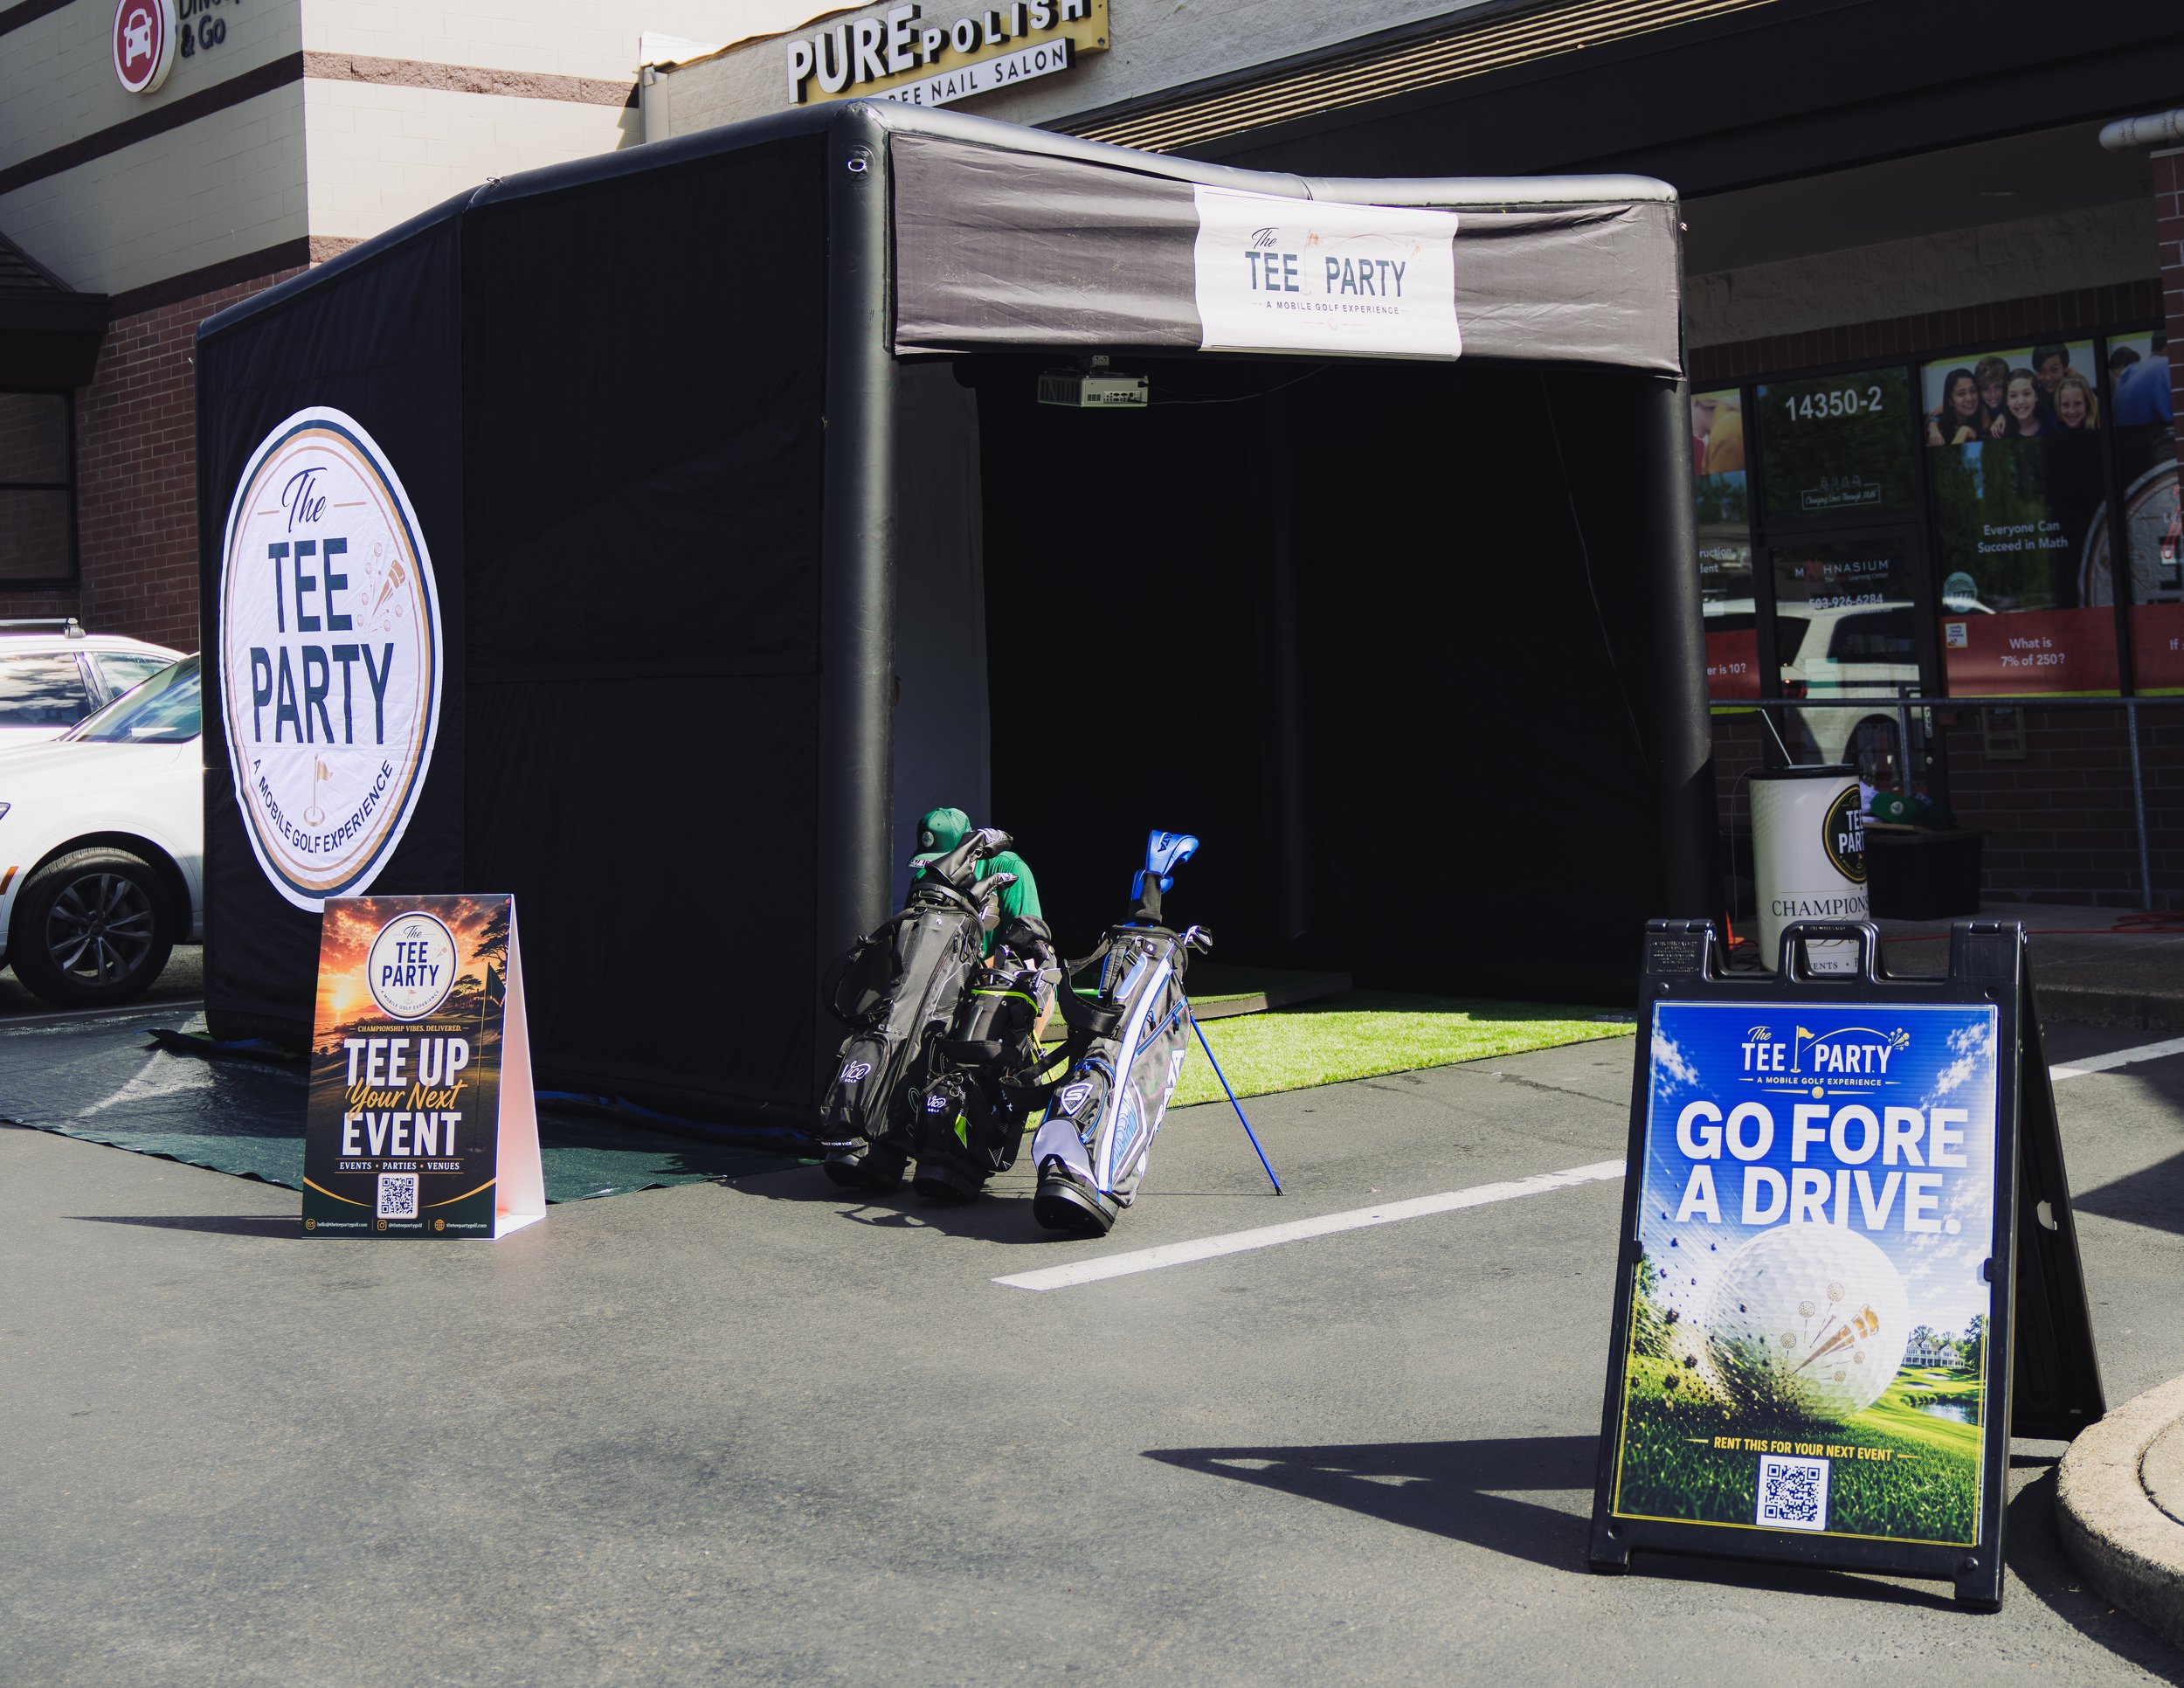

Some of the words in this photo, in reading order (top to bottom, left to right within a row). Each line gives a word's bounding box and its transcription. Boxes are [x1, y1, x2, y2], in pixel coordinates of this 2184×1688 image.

[181, 24, 195, 58] &
[198, 14, 226, 50] Go
[786, 3, 919, 104] PURE
[923, 0, 1089, 65] POLISH
[931, 72, 978, 101] NAIL
[994, 45, 1064, 82] SALON
[1252, 227, 1279, 249] The
[1245, 251, 1300, 292] TEE
[1325, 256, 1406, 297] PARTY
[1276, 301, 1311, 311] MOBILE
[1315, 302, 1339, 312] GOLF
[1343, 304, 1399, 315] EXPERIENCE
[1786, 385, 1883, 421] 14350-2
[281, 467, 328, 533] The
[1983, 523, 2035, 536] Everyone
[2038, 521, 2060, 532] Can
[1977, 540, 2022, 553] Succeed
[2025, 539, 2035, 550] in
[2039, 536, 2069, 549] Math
[267, 536, 353, 633] TEE
[2009, 638, 2040, 649] What
[2042, 636, 2052, 648] is
[1718, 664, 1727, 675] is
[1729, 662, 1747, 674] 10?
[2001, 655, 2020, 667] 7%
[2022, 654, 2034, 666] of
[2035, 653, 2065, 665] 250?
[249, 642, 394, 745] PARTY
[253, 758, 261, 776] A
[259, 775, 293, 842] MOBILE
[292, 835, 323, 854] GOLF
[322, 758, 394, 854] EXPERIENCE
[403, 924, 423, 939] The
[396, 941, 429, 964] TEE
[382, 965, 439, 987] PARTY
[384, 993, 398, 1007] MOBILE
[412, 990, 440, 1011] EXPERIENCE
[1747, 1026, 1773, 1041] The
[343, 1038, 410, 1087] TEE
[418, 1037, 470, 1087] UP
[1741, 1043, 1786, 1071] TEE
[1814, 1044, 1892, 1073] PARTY
[1827, 1078, 1881, 1087] EXPERIENCE
[345, 1076, 405, 1121] Your
[405, 1079, 468, 1110] Next
[342, 1111, 462, 1156] EVENT
[1676, 1100, 1775, 1162] GO
[1791, 1103, 1969, 1168] FORE
[1675, 1165, 1722, 1224] A
[1741, 1166, 1961, 1235] DRIVE.
[1713, 1436, 1742, 1450] RENT
[1743, 1437, 1768, 1452] THIS
[1770, 1440, 1792, 1455] FOR
[1794, 1442, 1823, 1456] YOUR
[1826, 1444, 1855, 1459] NEXT
[1857, 1446, 1893, 1462] EVENT
